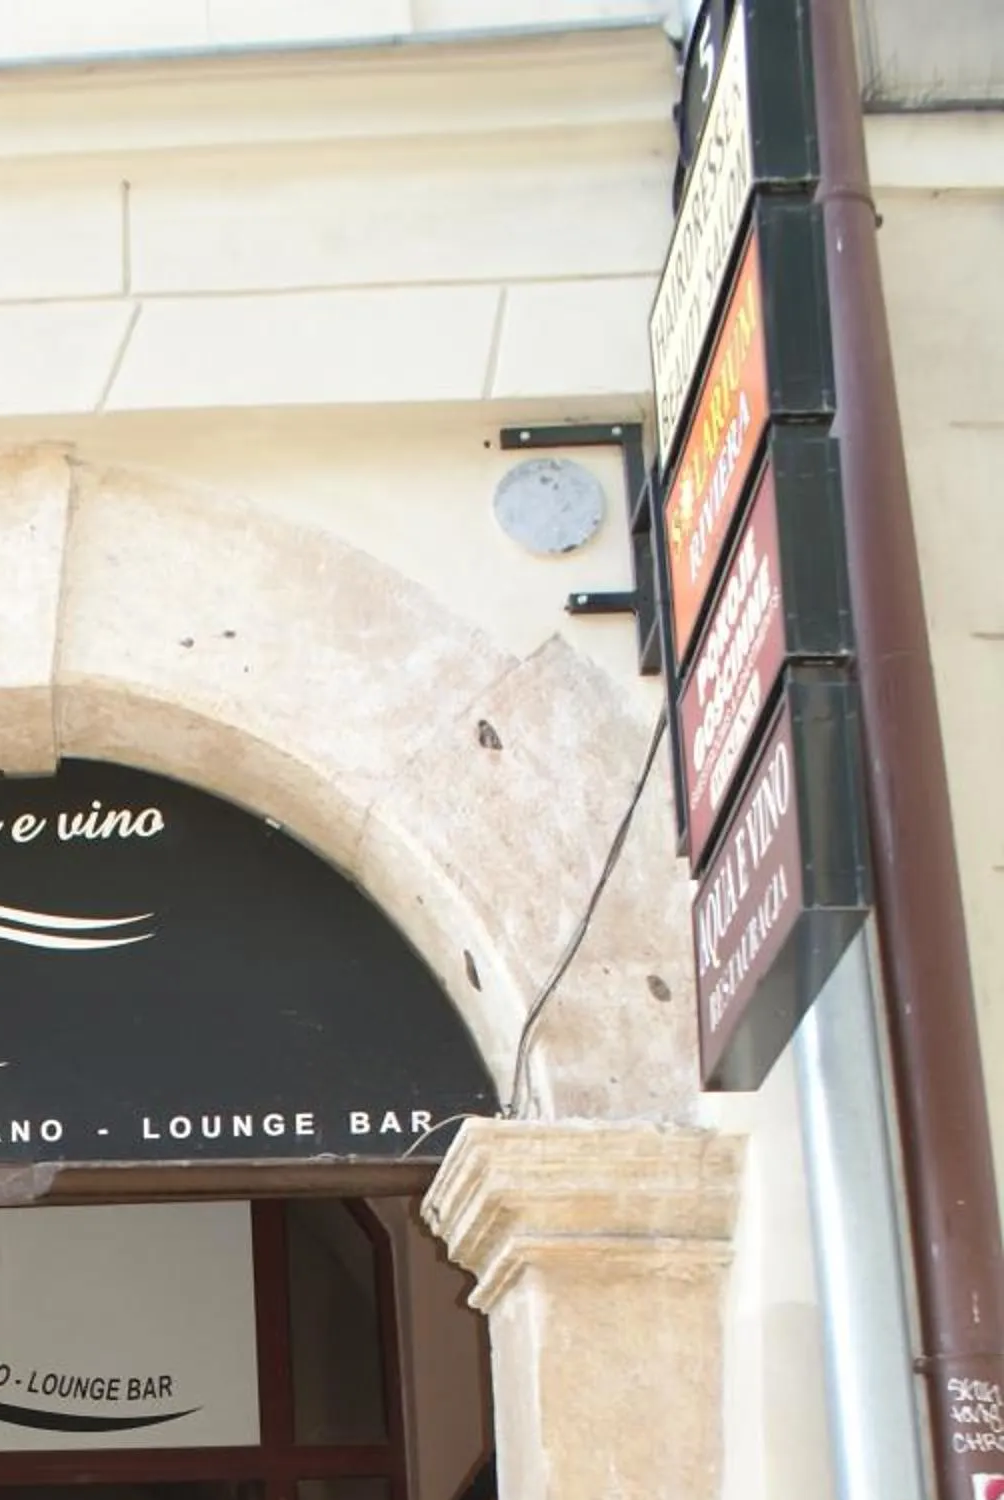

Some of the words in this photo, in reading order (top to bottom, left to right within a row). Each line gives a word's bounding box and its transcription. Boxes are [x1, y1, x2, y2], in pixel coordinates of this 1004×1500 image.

[660, 292, 701, 449] BEAUTY
[705, 128, 747, 308] SALON
[689, 391, 750, 584] RIVIERA
[697, 525, 756, 707] POKOJE
[11, 813, 47, 843] e
[57, 799, 165, 842] vino
[698, 857, 738, 977] AQUA
[734, 827, 750, 901] E
[746, 742, 789, 869] VINO
[142, 1112, 316, 1140] LOUNGE
[349, 1110, 433, 1135] BAR
[26, 1370, 122, 1402] LOUNGE
[126, 1375, 174, 1402] BAR
